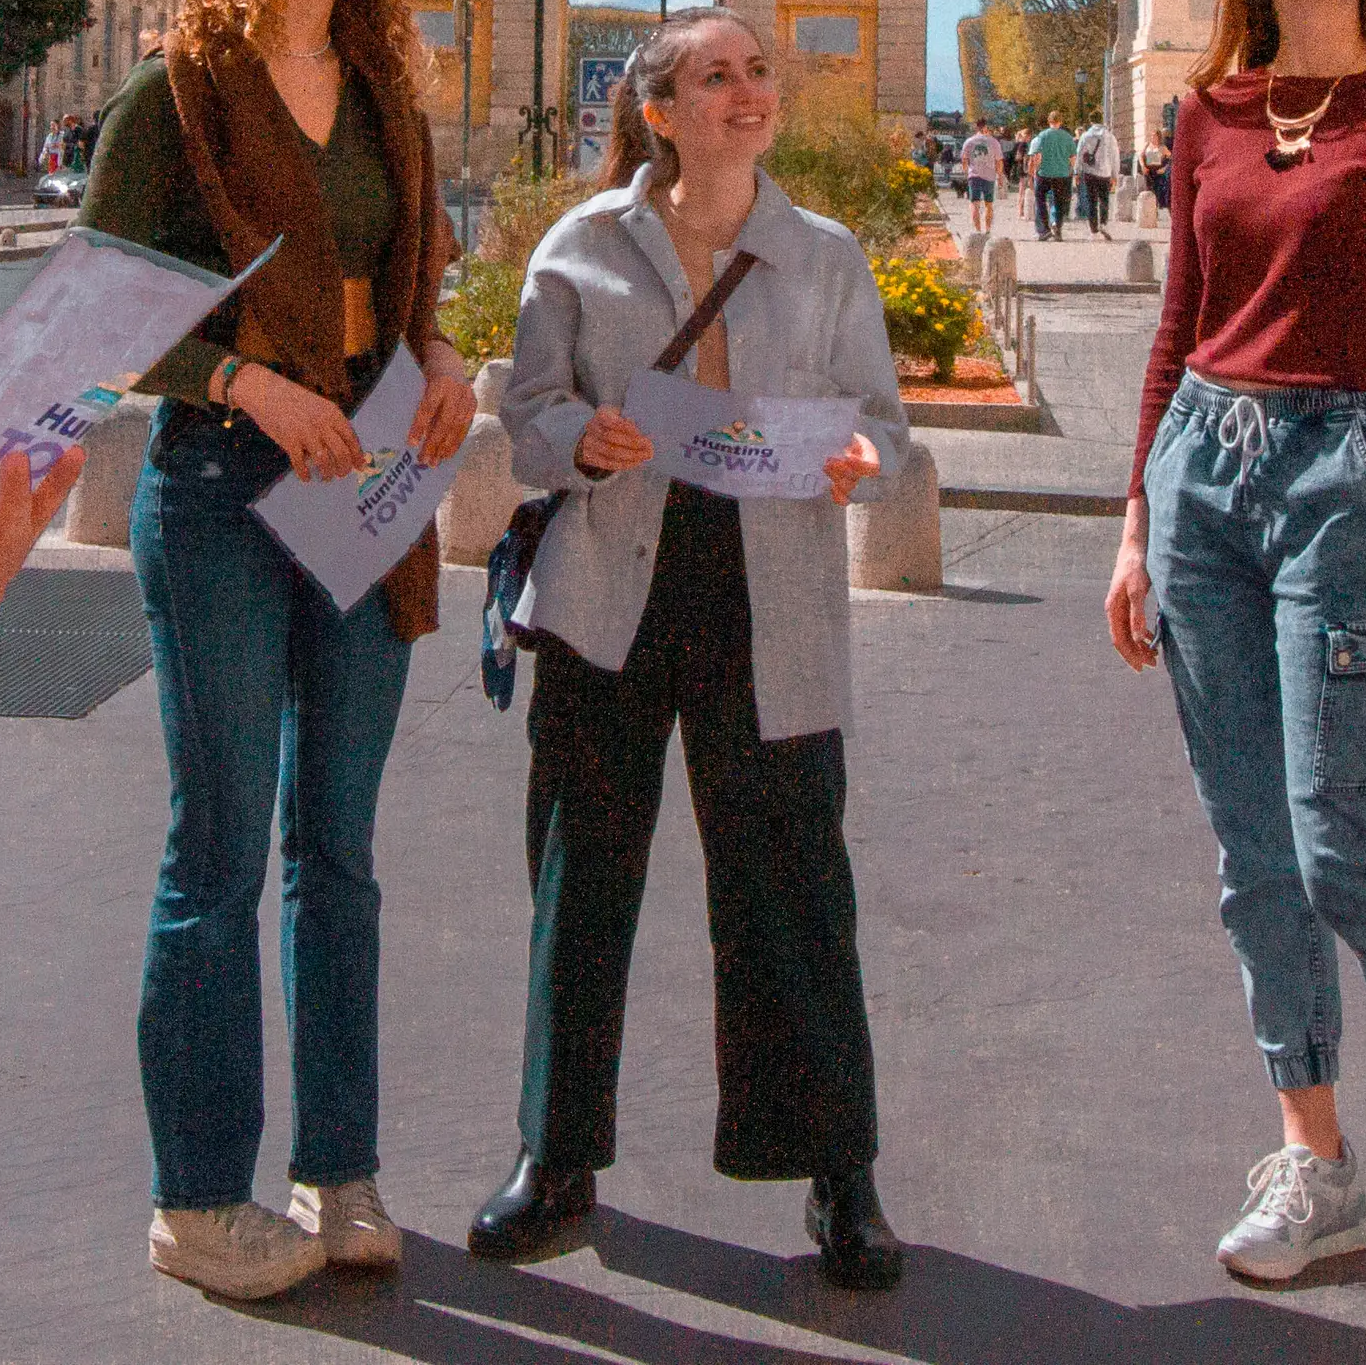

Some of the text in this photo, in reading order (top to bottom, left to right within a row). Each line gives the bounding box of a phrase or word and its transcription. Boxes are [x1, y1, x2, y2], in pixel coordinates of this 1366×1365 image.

[680, 442, 781, 474] TOWN
[692, 434, 774, 458] Hunting
[356, 449, 413, 516] Hunting
